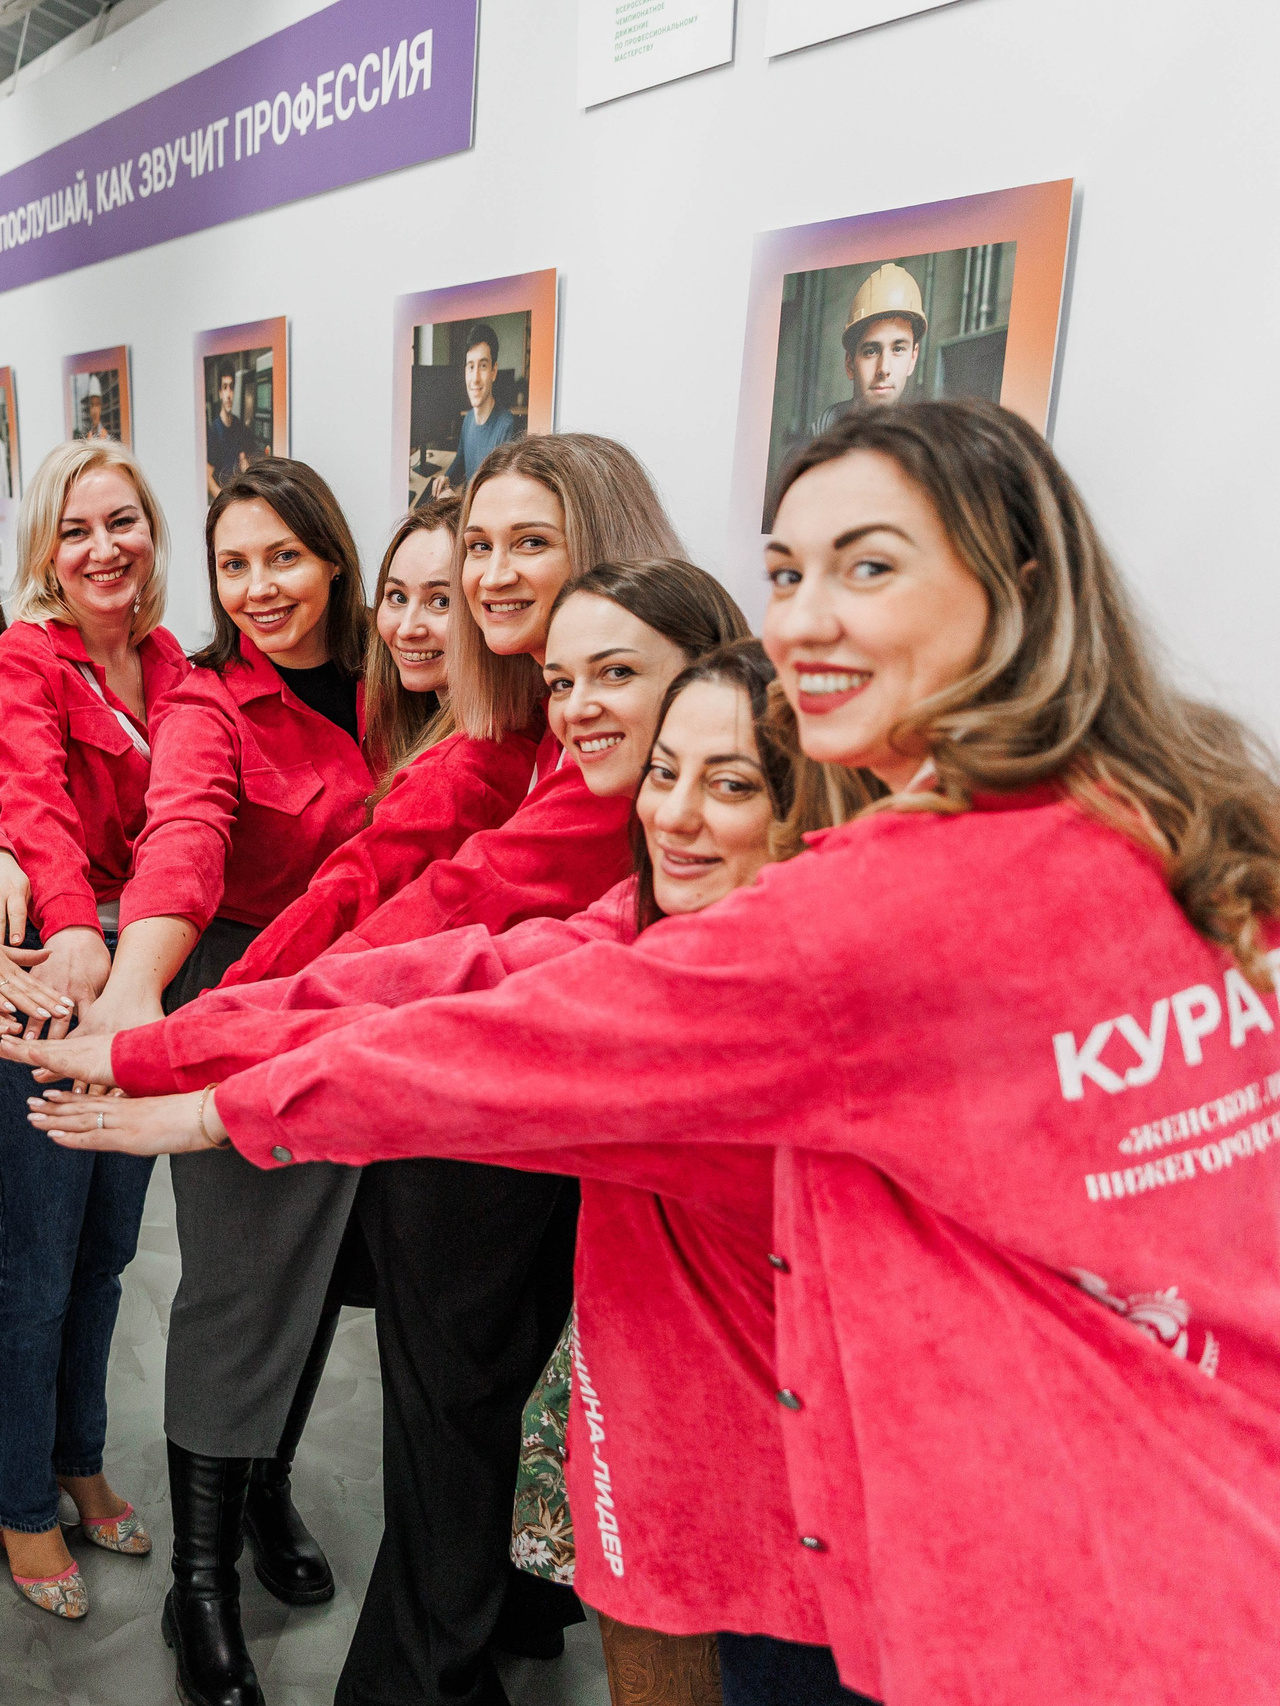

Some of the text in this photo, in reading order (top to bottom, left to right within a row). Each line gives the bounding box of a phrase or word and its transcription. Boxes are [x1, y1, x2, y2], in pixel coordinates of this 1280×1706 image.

[615, 2, 665, 26] ЧЕМПИОНАТНОЕ
[614, 20, 649, 40] ДВИЖЕНИЕ
[614, 14, 699, 51] ПО ПРОФЕССИОНАЛЬНОМУ
[614, 43, 655, 62] МАСТЕРСТВУ
[96, 159, 135, 215] КАК
[138, 117, 229, 198] ЗВУЧИТ
[235, 29, 434, 161] ПРОФЕССИЯ
